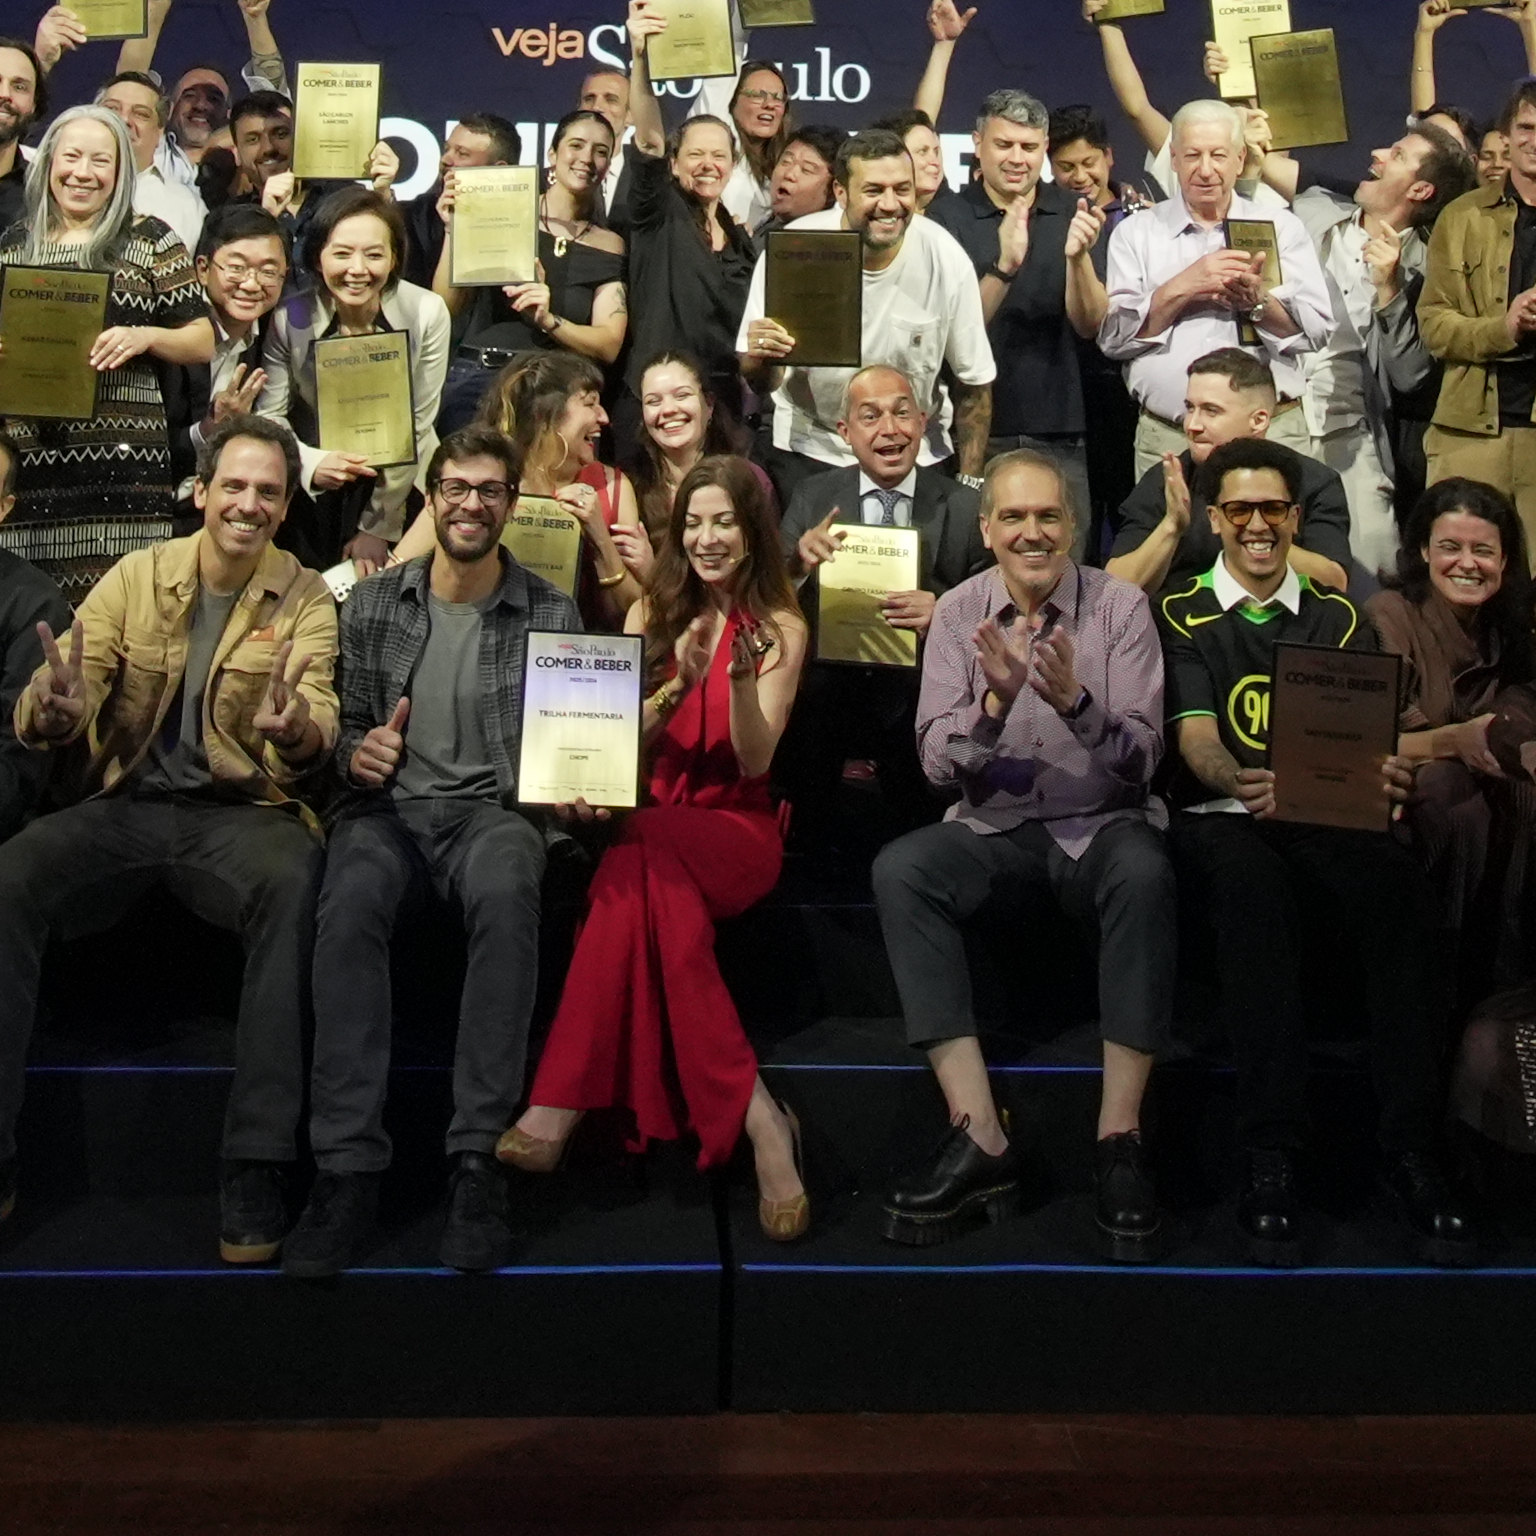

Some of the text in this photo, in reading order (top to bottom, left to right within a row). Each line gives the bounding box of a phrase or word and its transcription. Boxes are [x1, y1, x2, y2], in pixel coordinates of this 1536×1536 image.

[1219, 7, 1250, 16] COMER
[1257, 4, 1283, 13] BEBER
[491, 22, 584, 66] veja
[303, 79, 337, 88] COMER
[345, 79, 372, 88] BEBER
[460, 185, 494, 194] COMER
[502, 183, 530, 193] BEBER
[10, 288, 53, 301] COMER
[368, 350, 399, 363] BEBER
[510, 516, 534, 526] MER
[543, 518, 575, 530] BEBER
[836, 544, 868, 554] OMER
[877, 547, 909, 558] BEBER
[866, 588, 888, 596] FASAN
[535, 656, 632, 672] COMER & BEBER
